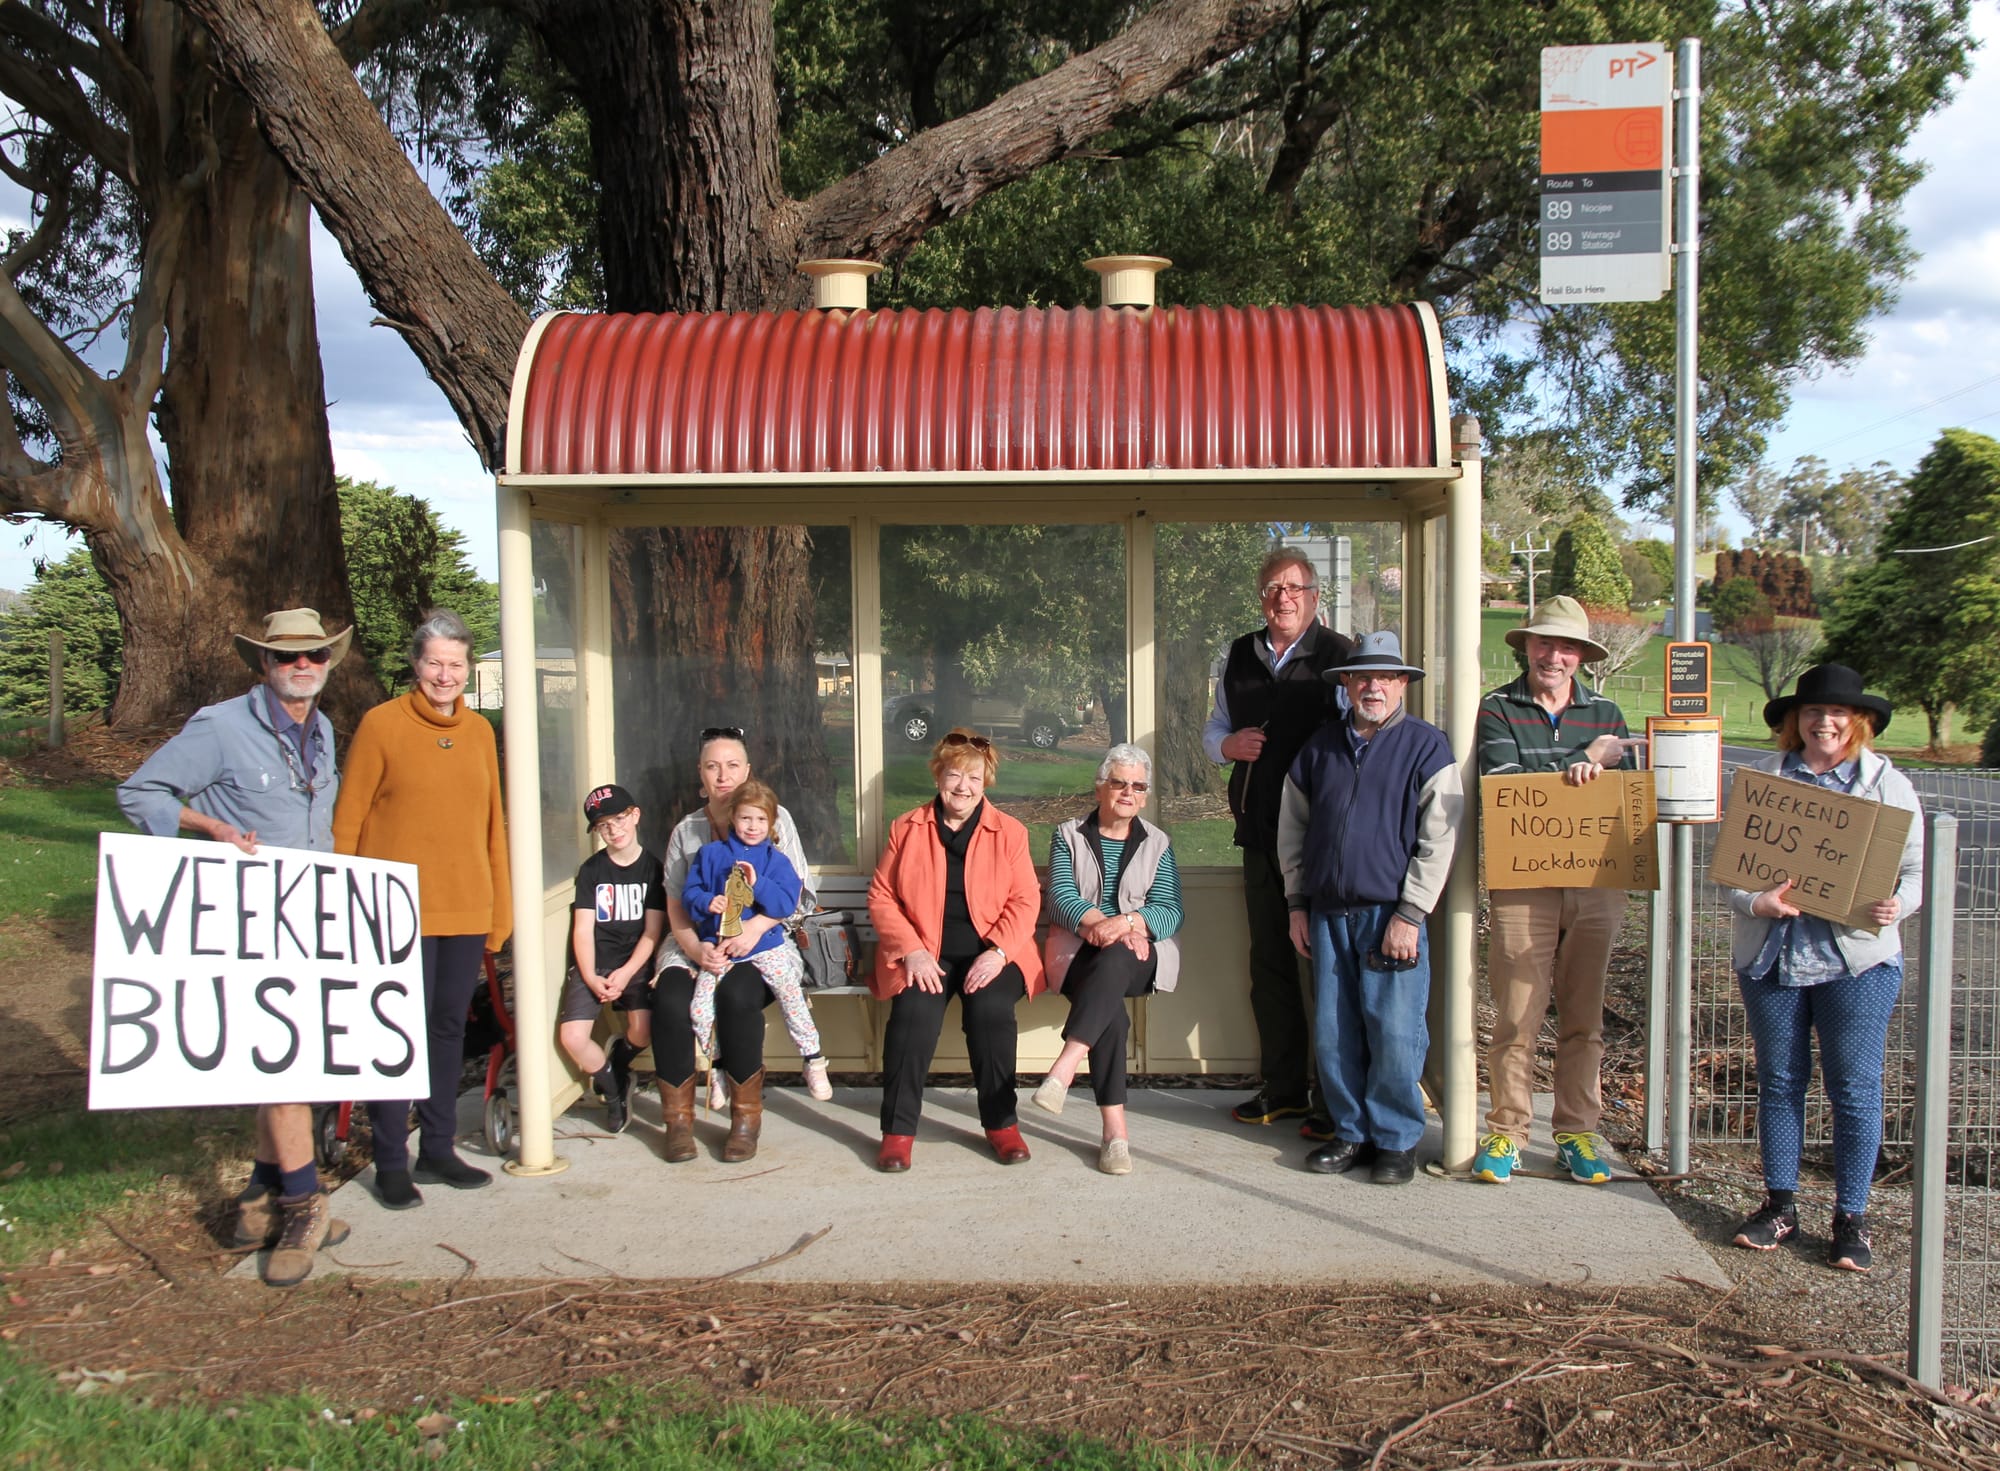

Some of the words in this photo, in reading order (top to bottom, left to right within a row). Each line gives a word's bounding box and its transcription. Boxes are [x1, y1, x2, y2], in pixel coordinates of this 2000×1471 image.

[1546, 179, 1574, 189] Route
[1582, 178, 1593, 188] To
[1547, 200, 1572, 220] 89
[1581, 203, 1613, 214] Noojee
[1547, 231, 1572, 251] 89
[1581, 229, 1621, 241] Warragul
[1581, 240, 1613, 250] Station
[1546, 286, 1563, 295] Hail
[1566, 285, 1583, 294] Bus
[1585, 284, 1606, 293] Here
[1497, 786, 1548, 808] END
[1745, 779, 1849, 830] WEEKEND
[1629, 781, 1644, 846] WEEKEND
[1511, 813, 1620, 839] NOOJEE
[1743, 814, 1802, 854] BUS
[1814, 838, 1849, 866] for
[1512, 851, 1617, 872] Lockdown
[1632, 854, 1648, 883] BUS
[1737, 852, 1836, 900] NOOJEE
[105, 853, 418, 966] WEEKEND
[100, 975, 416, 1078] BUSES
